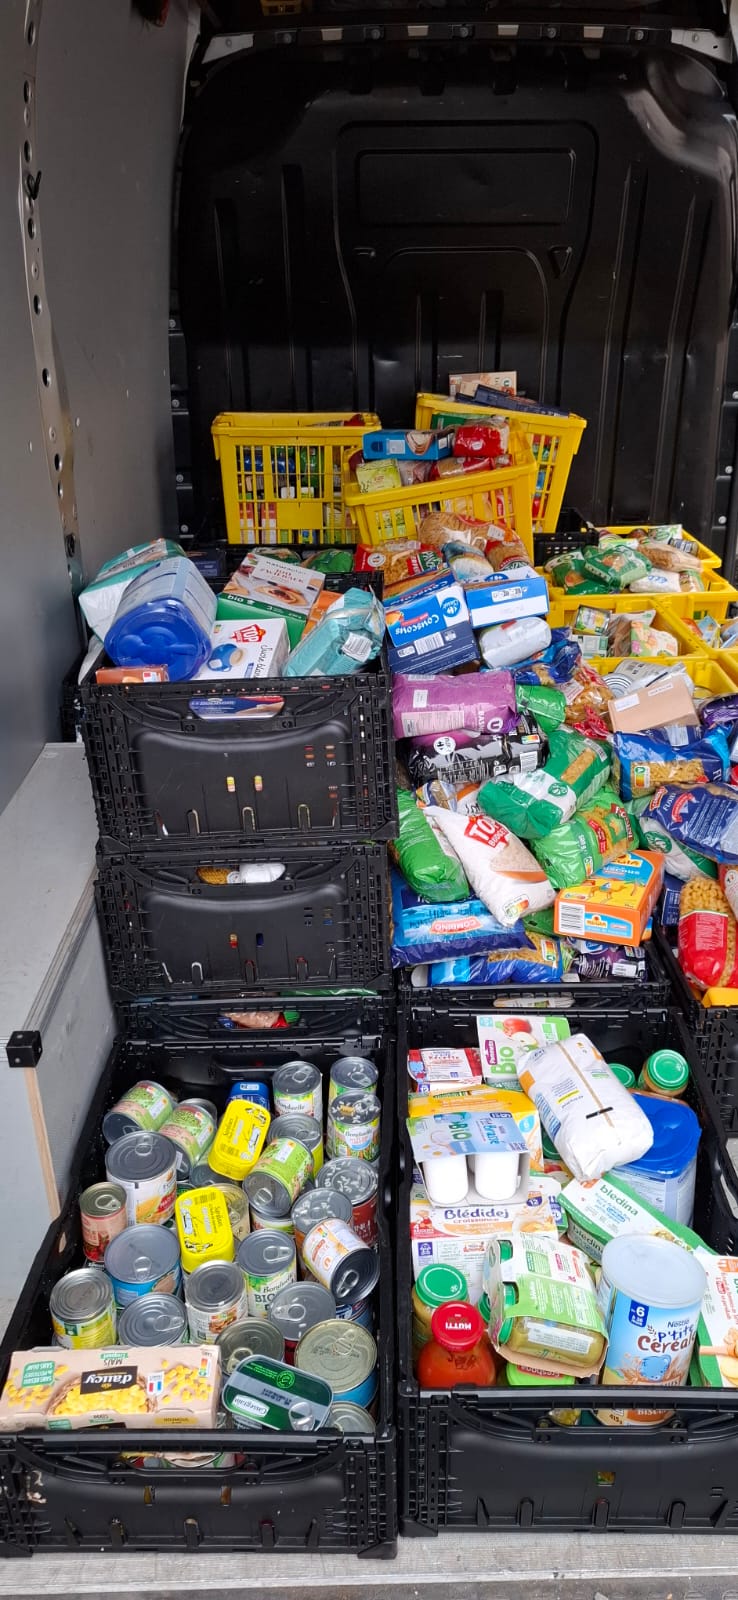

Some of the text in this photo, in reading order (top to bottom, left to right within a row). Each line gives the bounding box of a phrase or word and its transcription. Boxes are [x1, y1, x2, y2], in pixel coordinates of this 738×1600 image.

[395, 614, 440, 636] Couscous
[434, 920, 476, 931] COMBINO
[490, 1046, 517, 1075] Bio
[599, 1184, 639, 1217] bledina
[444, 1206, 509, 1220] Blédidej
[571, 1223, 602, 1251] bledin
[636, 1306, 645, 1317] 6
[445, 1322, 472, 1330] MUTTI
[84, 1374, 133, 1385] d'aucy
